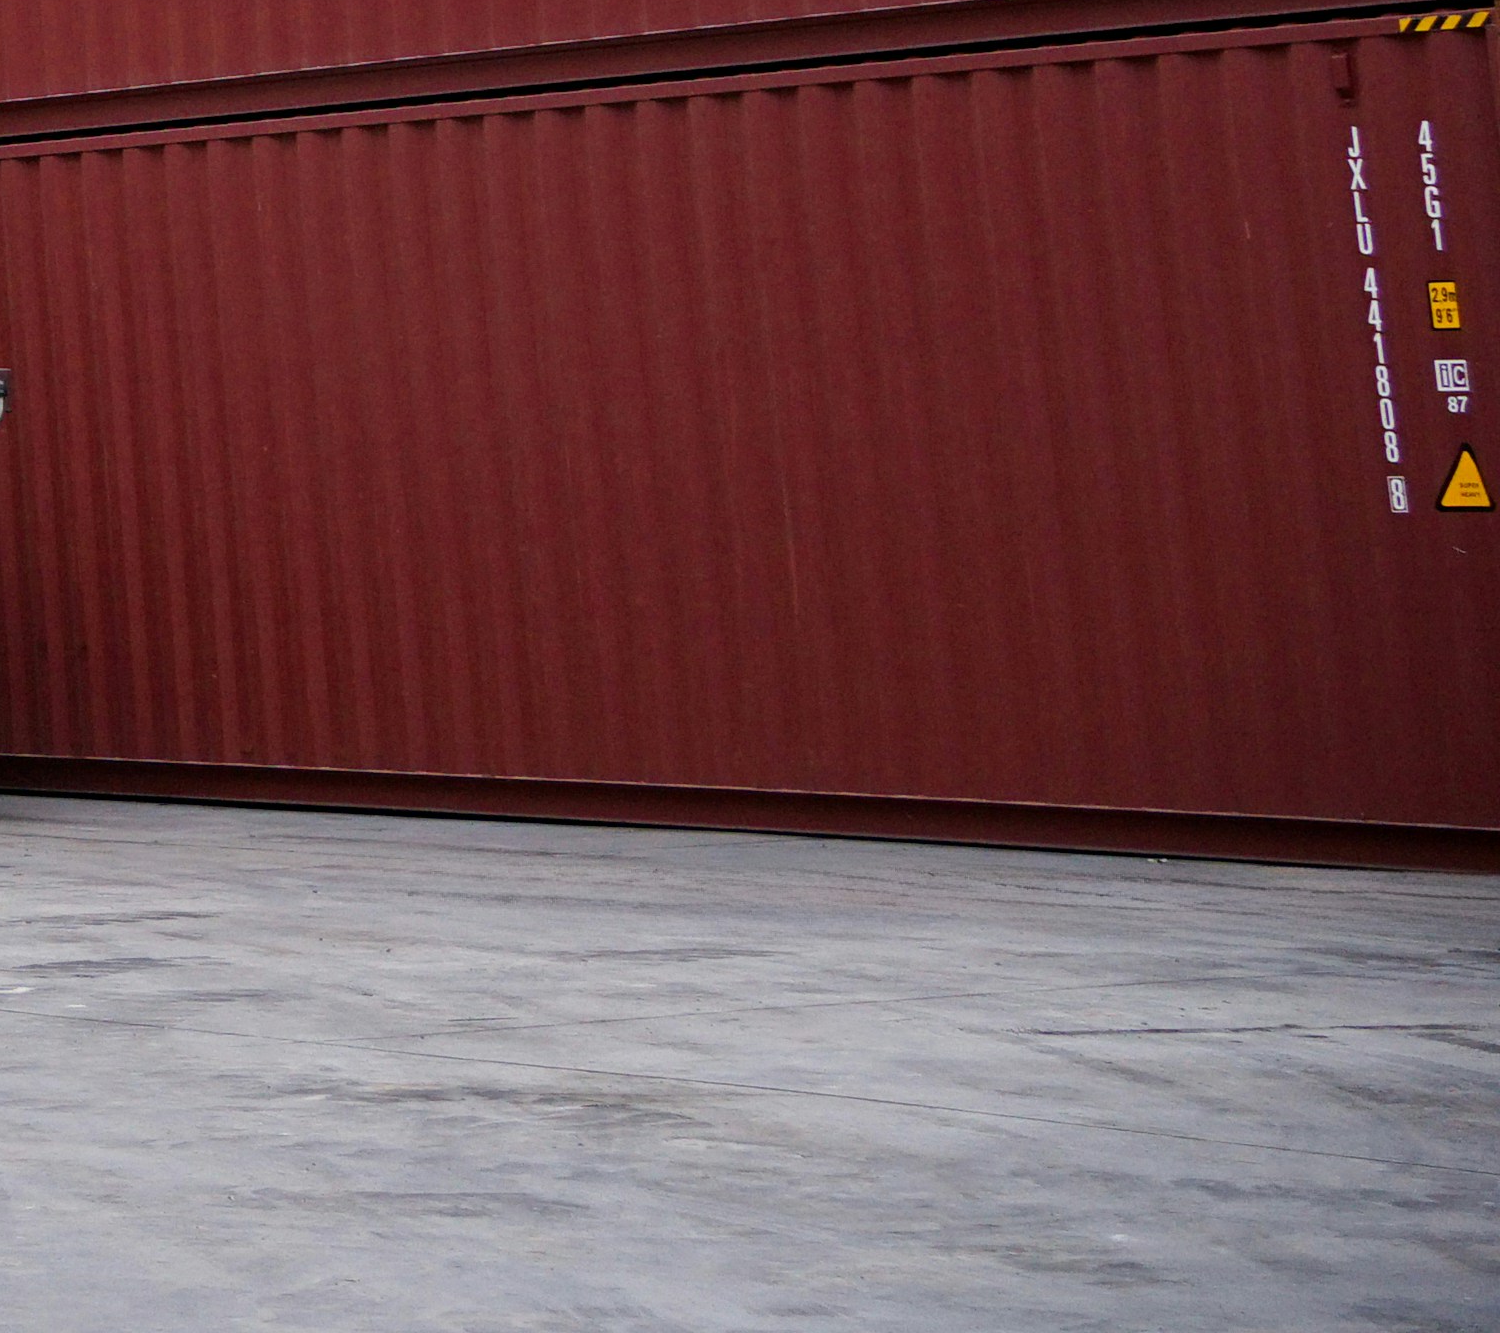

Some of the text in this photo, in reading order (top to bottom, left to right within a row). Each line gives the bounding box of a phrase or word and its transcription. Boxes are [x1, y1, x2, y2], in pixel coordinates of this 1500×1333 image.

[1418, 120, 1444, 251] 45G1
[1347, 126, 1375, 256] JXLU
[1362, 266, 1400, 464] 441808
[1447, 396, 1468, 413] 87
